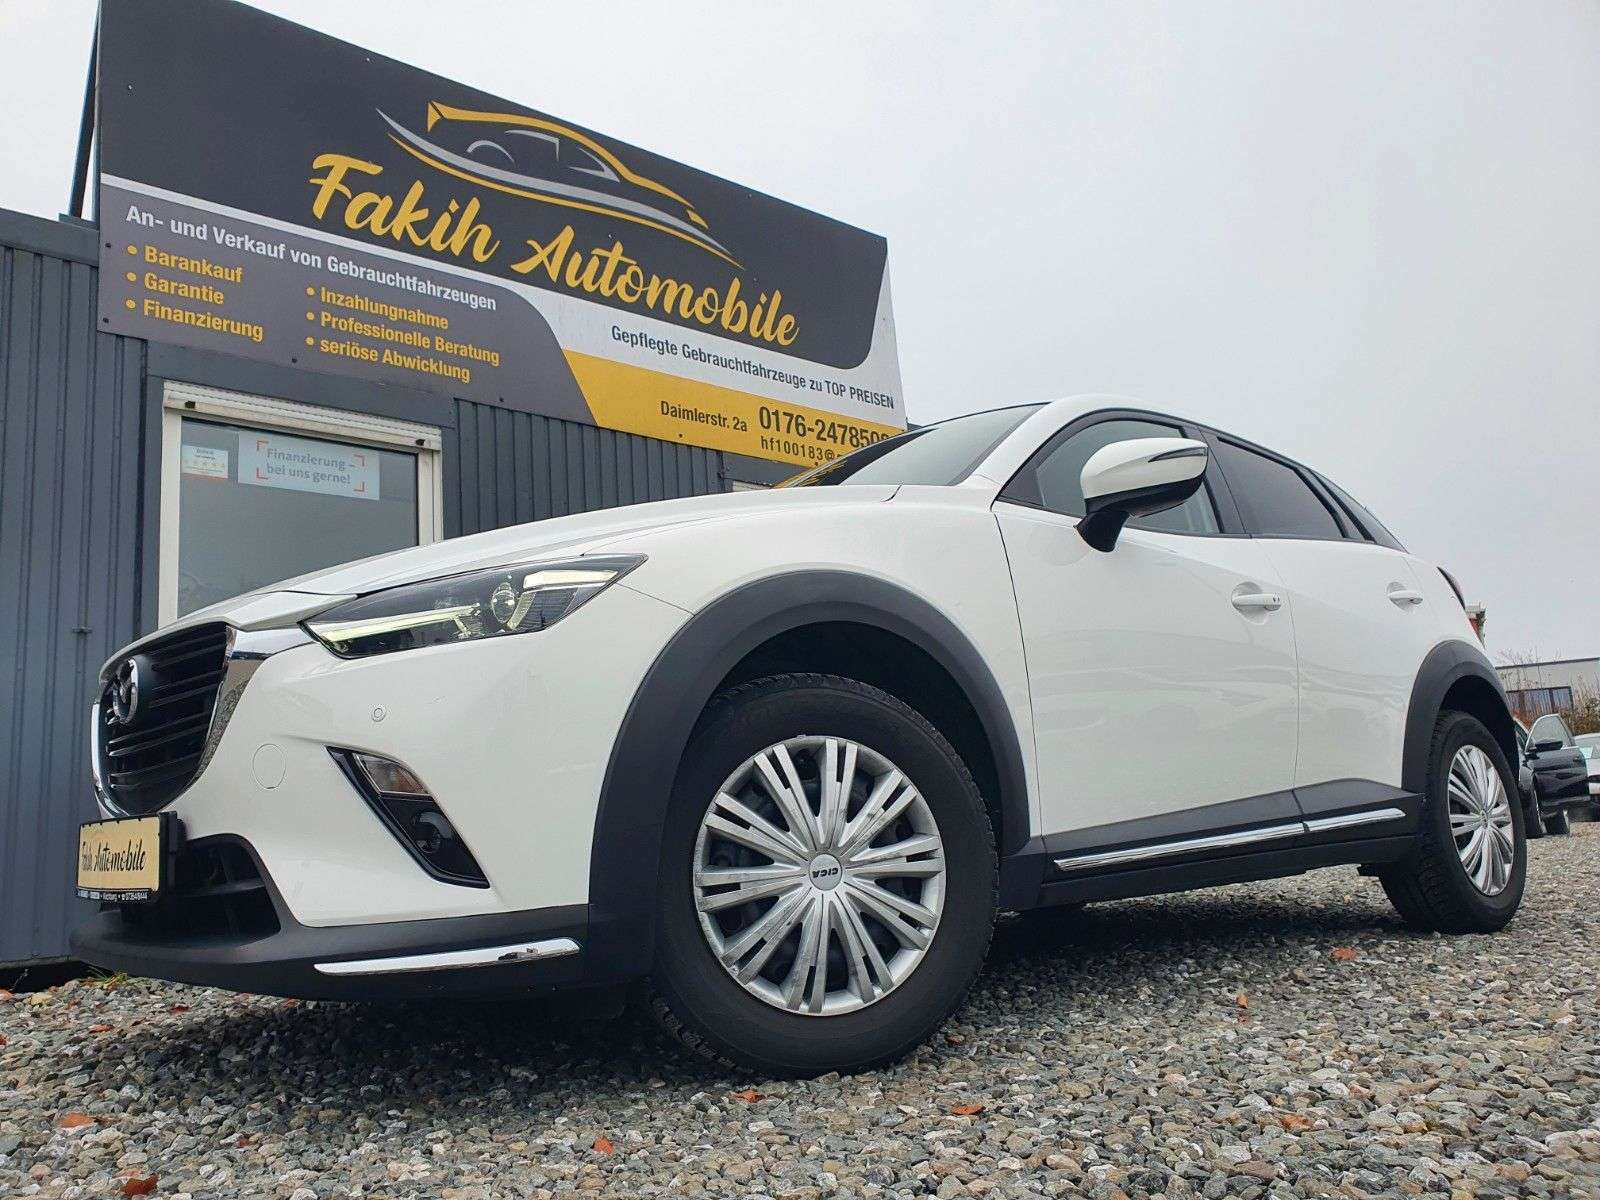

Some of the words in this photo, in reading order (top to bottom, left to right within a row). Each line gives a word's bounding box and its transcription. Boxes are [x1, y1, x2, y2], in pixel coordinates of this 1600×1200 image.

[125, 205, 164, 228] An-
[170, 218, 208, 241] und
[213, 226, 286, 260] Verkauf
[290, 249, 322, 269] von
[327, 256, 497, 311] Gebrauchtfahrzeugen
[143, 245, 244, 283] Barankauf
[309, 153, 499, 263] Fakih
[512, 225, 799, 345] Automobile
[143, 272, 225, 305] Garantie
[320, 287, 449, 330] Inzahlungnahme
[143, 298, 264, 343] Finanzierung
[320, 311, 431, 349] Professionelle
[435, 336, 501, 367] Beratung
[320, 337, 379, 362] seriöse
[381, 350, 471, 384] Abwicklung
[611, 325, 679, 356] Gepflegte
[681, 344, 806, 390] Gebrauchtfahrzeuge
[809, 377, 823, 393] zu
[825, 380, 847, 398] TOP
[849, 386, 895, 410] PREISEN
[660, 400, 731, 430] Daimlerstr.
[732, 415, 748, 433] 2a
[266, 448, 345, 471] Finanzierung
[760, 435, 843, 462] hf100183@
[266, 462, 289, 476] bei
[290, 468, 310, 479] uns
[312, 472, 351, 485] gerne!
